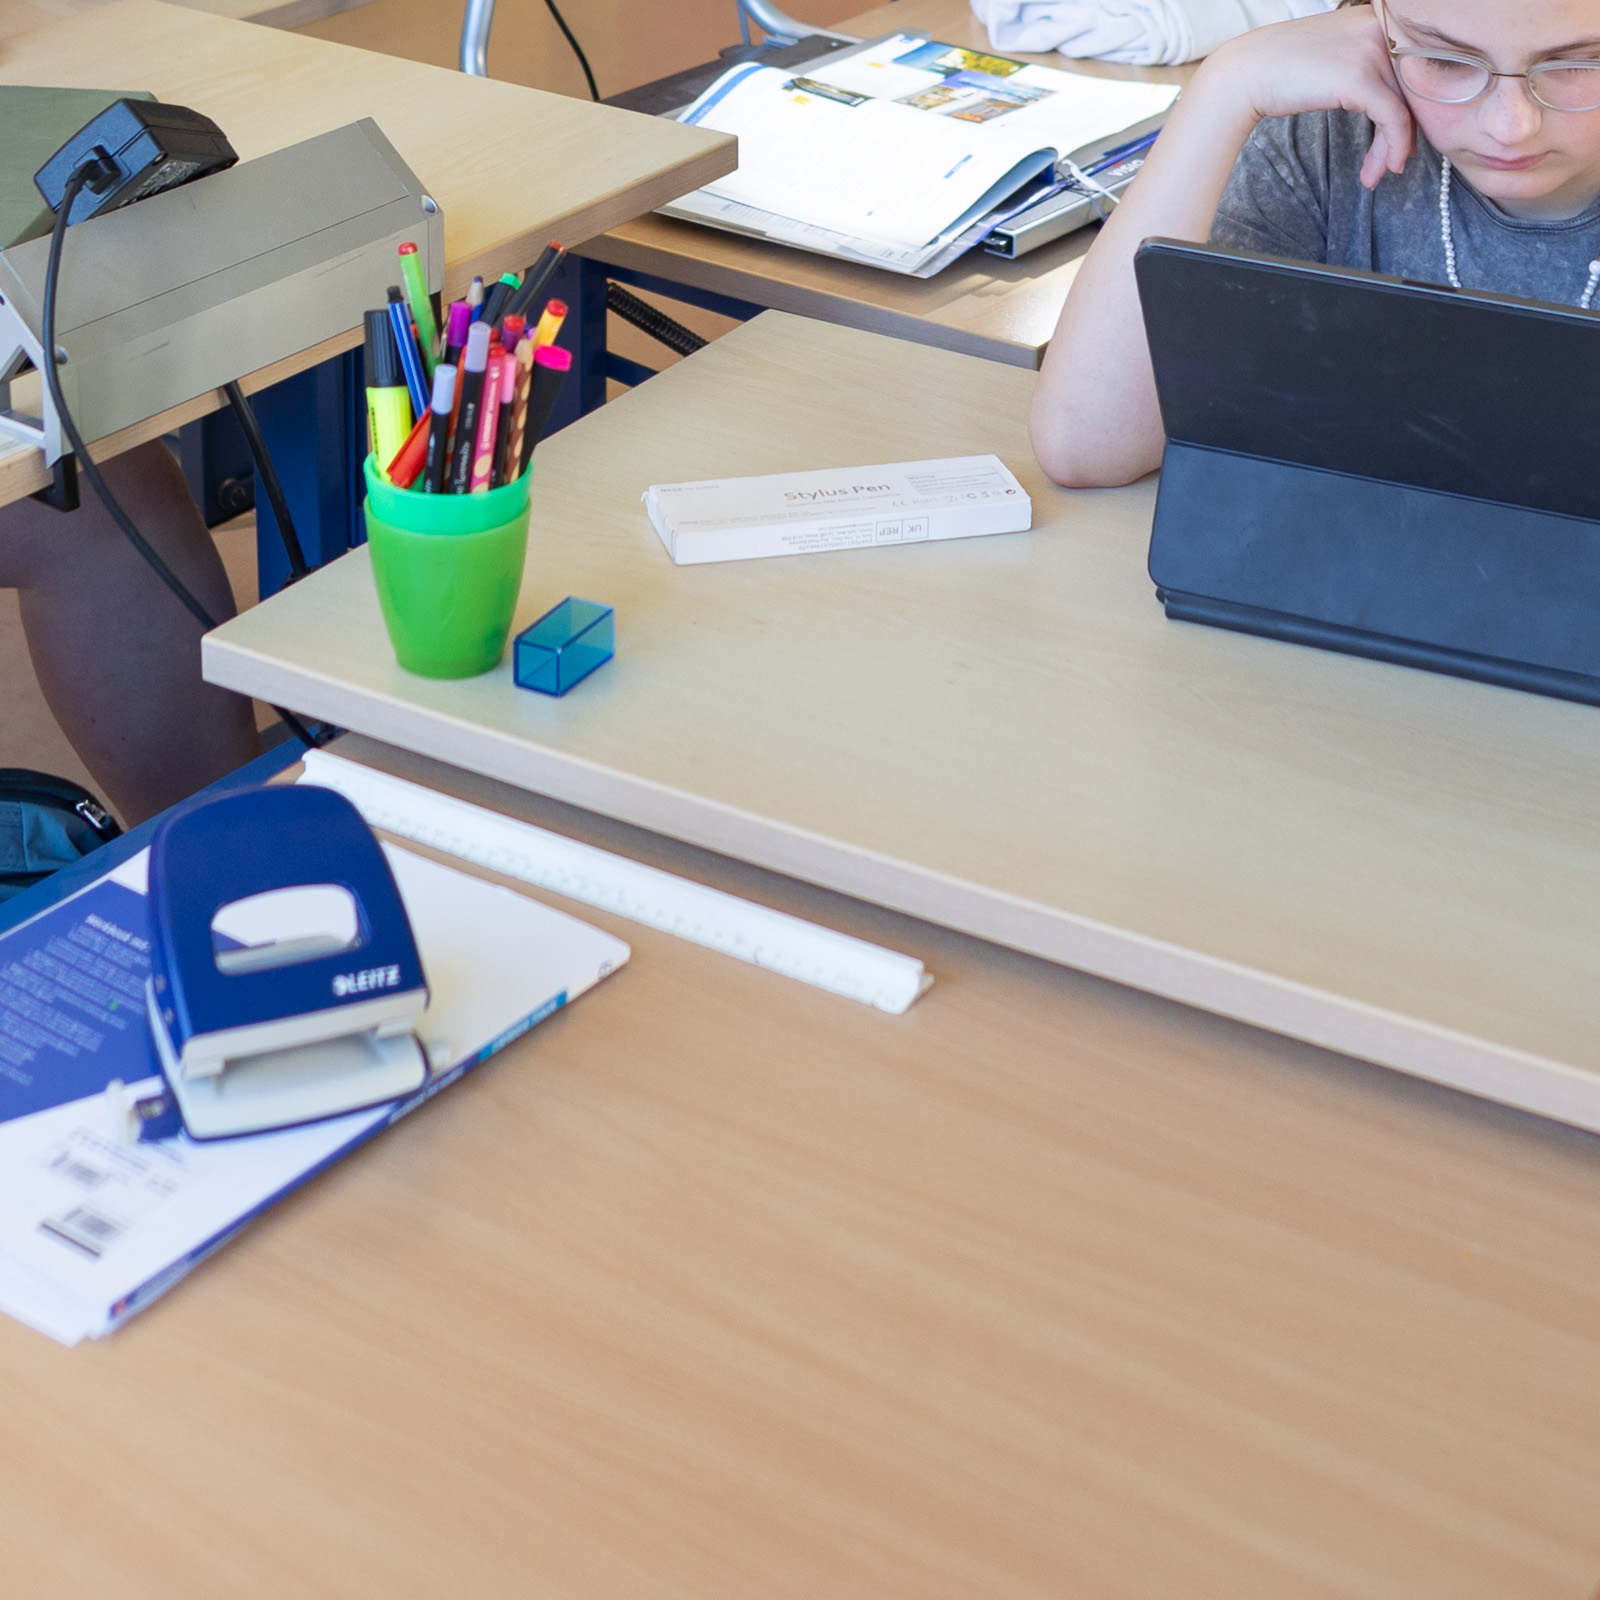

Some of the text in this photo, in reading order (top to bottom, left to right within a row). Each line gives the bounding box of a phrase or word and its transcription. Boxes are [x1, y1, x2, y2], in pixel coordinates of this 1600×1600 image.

[783, 482, 892, 502] Stylus Pen
[878, 525, 900, 537] REP
[907, 523, 923, 534] UK
[348, 964, 401, 994] LEITZ
